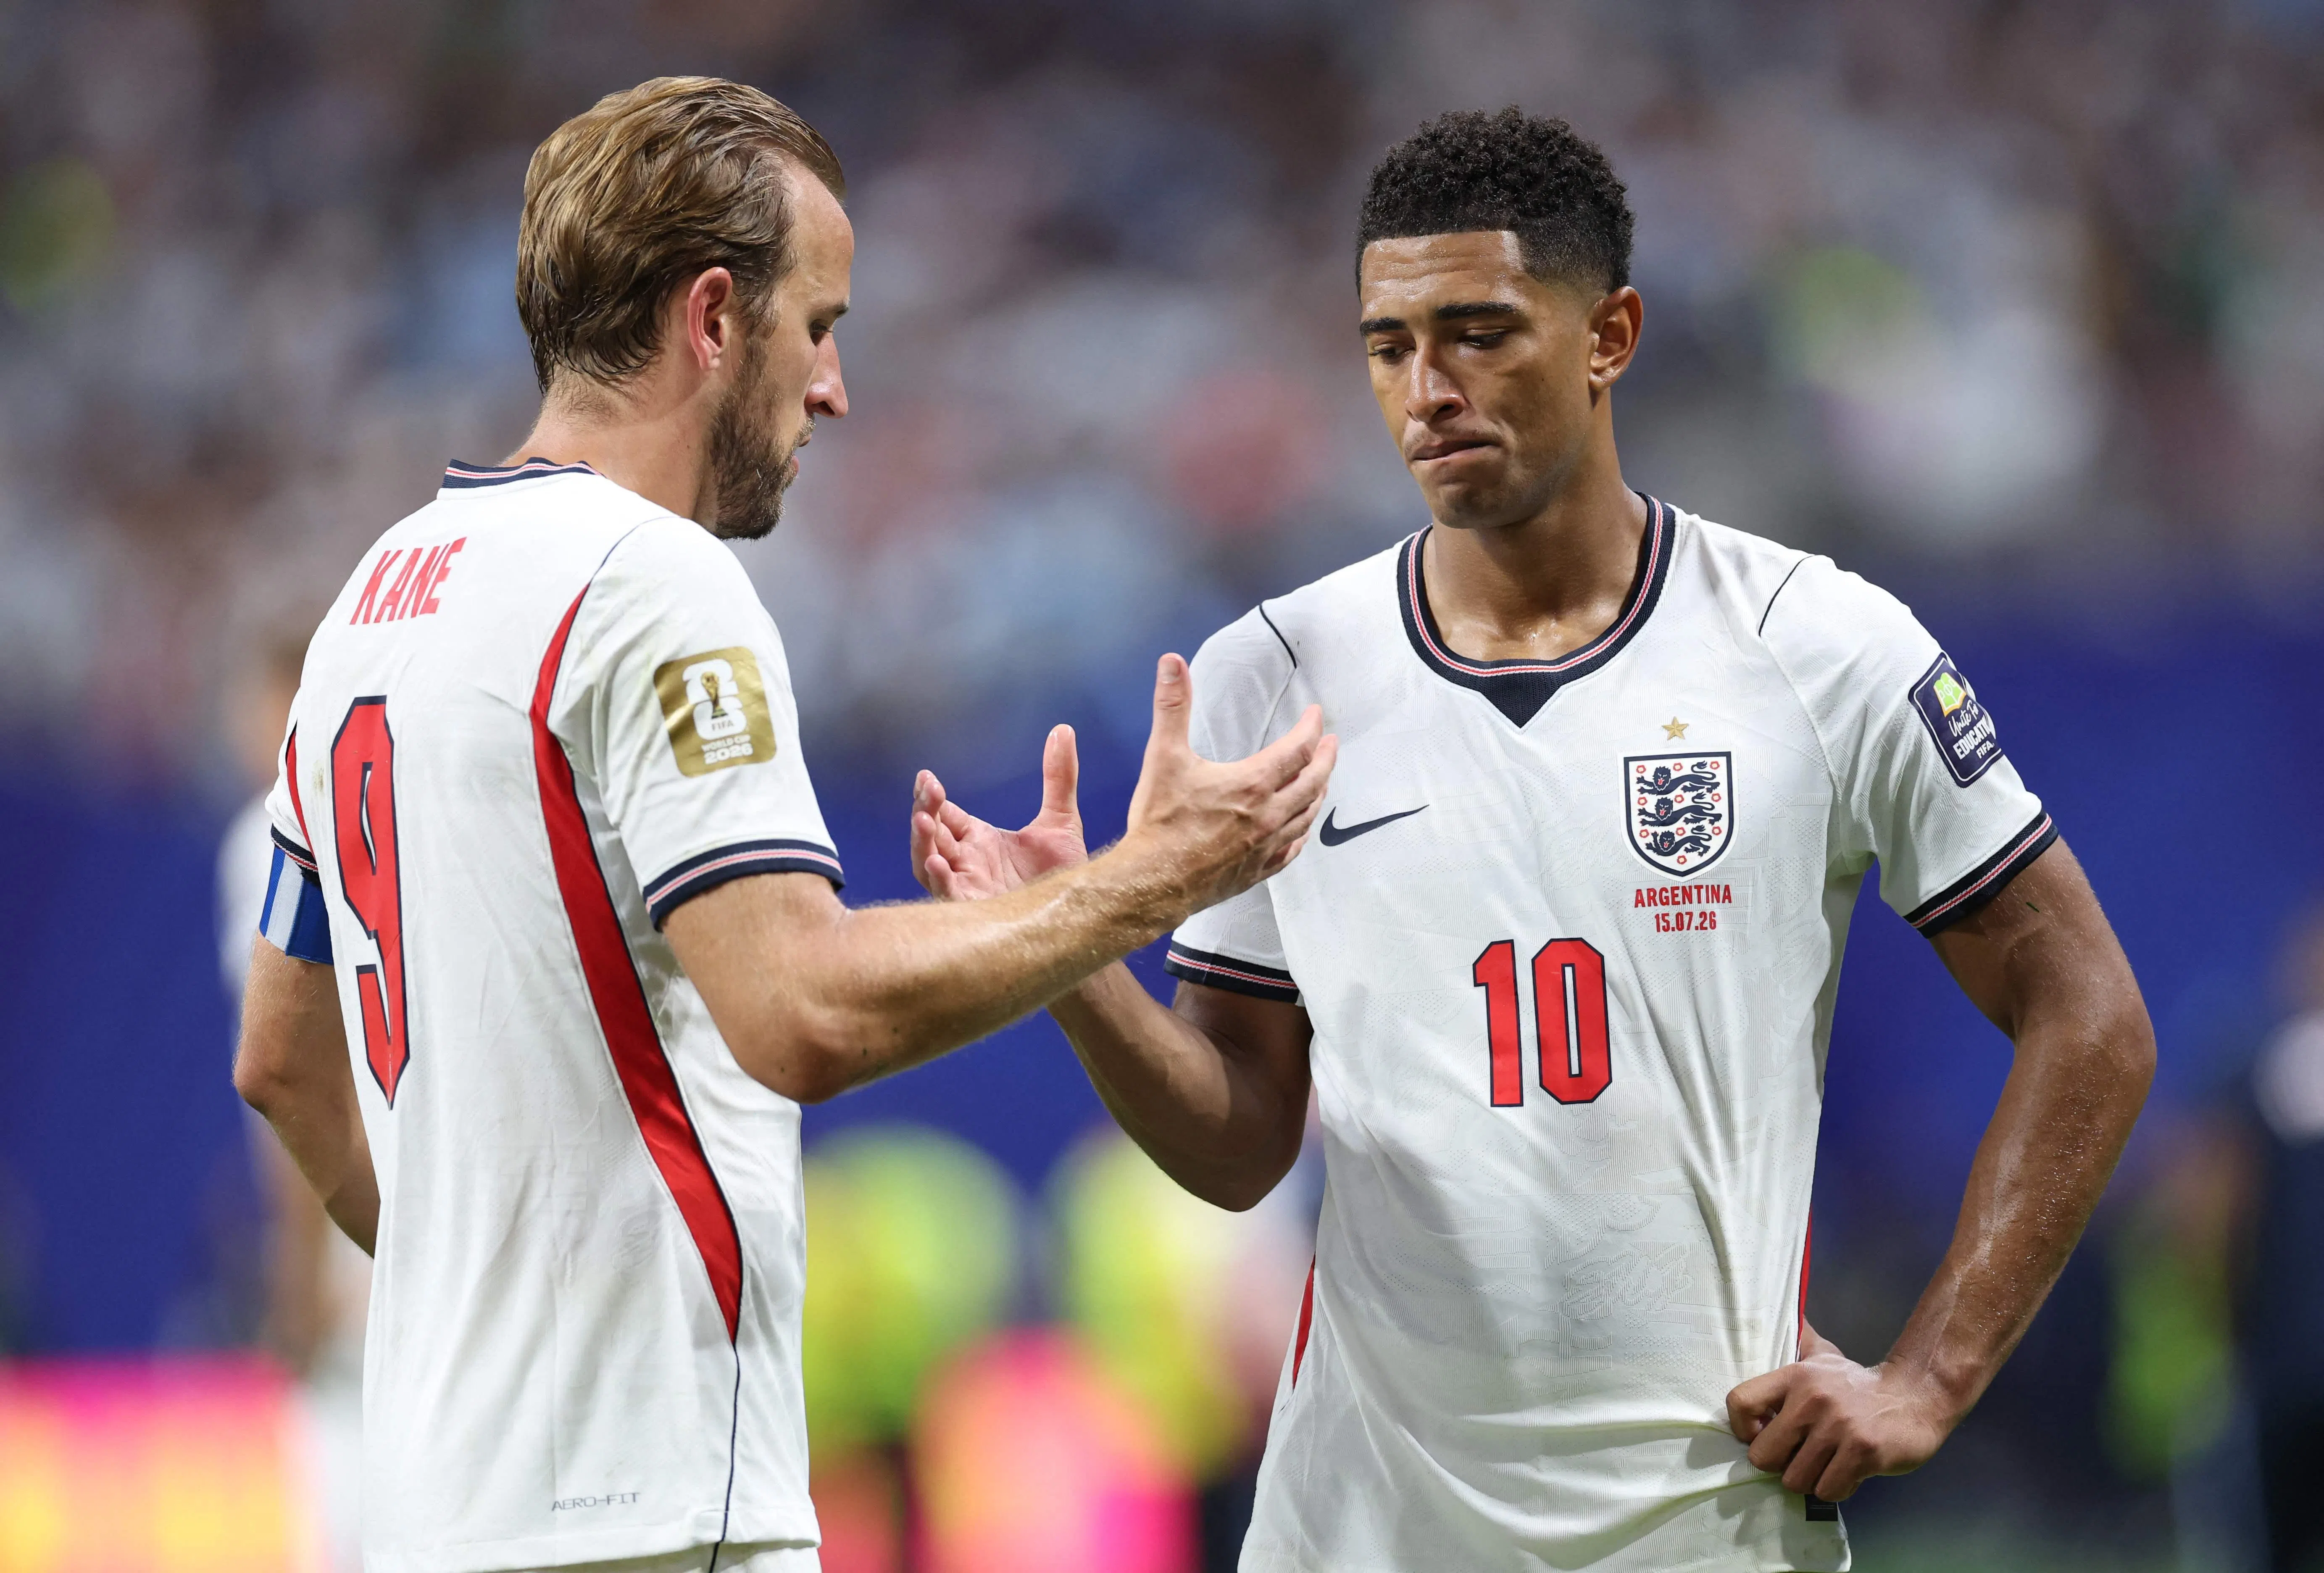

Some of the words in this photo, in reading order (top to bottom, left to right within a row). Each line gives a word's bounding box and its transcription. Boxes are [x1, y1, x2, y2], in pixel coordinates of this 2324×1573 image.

[349, 536, 467, 625] KANE
[711, 720, 734, 731] FIFA
[1948, 710, 1971, 737] Unite
[704, 742, 753, 764] 2026
[1976, 740, 1994, 759] FIFA
[331, 694, 410, 1111] 9
[1634, 884, 1732, 908] ARGENTINA
[1654, 911, 1716, 933] 15.07.26
[1472, 937, 1613, 1107] 10
[551, 1492, 641, 1512] AERO-FIT
